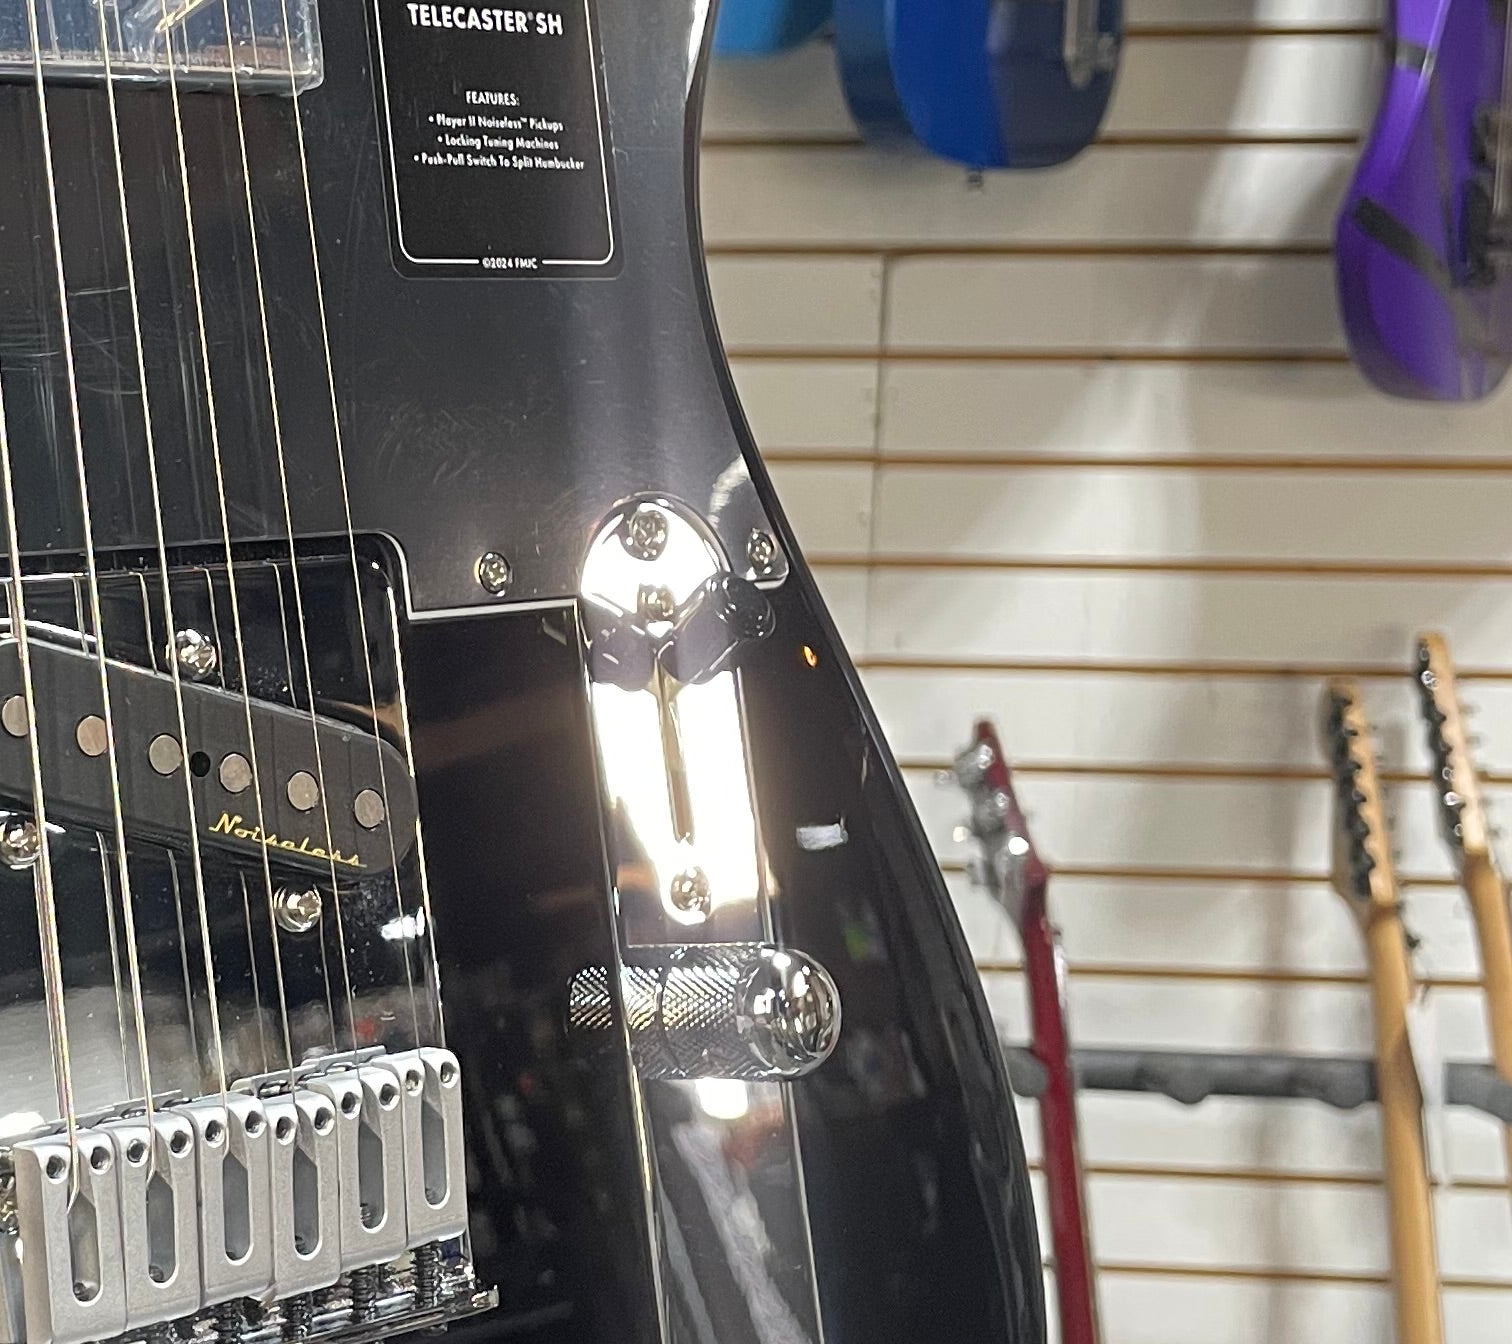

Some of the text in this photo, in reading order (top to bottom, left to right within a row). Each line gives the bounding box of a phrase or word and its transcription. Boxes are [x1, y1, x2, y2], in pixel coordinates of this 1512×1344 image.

[535, 12, 564, 36] SH
[465, 90, 521, 107] FEATURES:
[435, 113, 467, 129] Player
[529, 117, 564, 133] Pickups
[444, 133, 560, 151] Locking Tuning Machines
[421, 151, 585, 171] Push-Pull Switch To Split Humbucker
[208, 810, 368, 869] Noiseless
